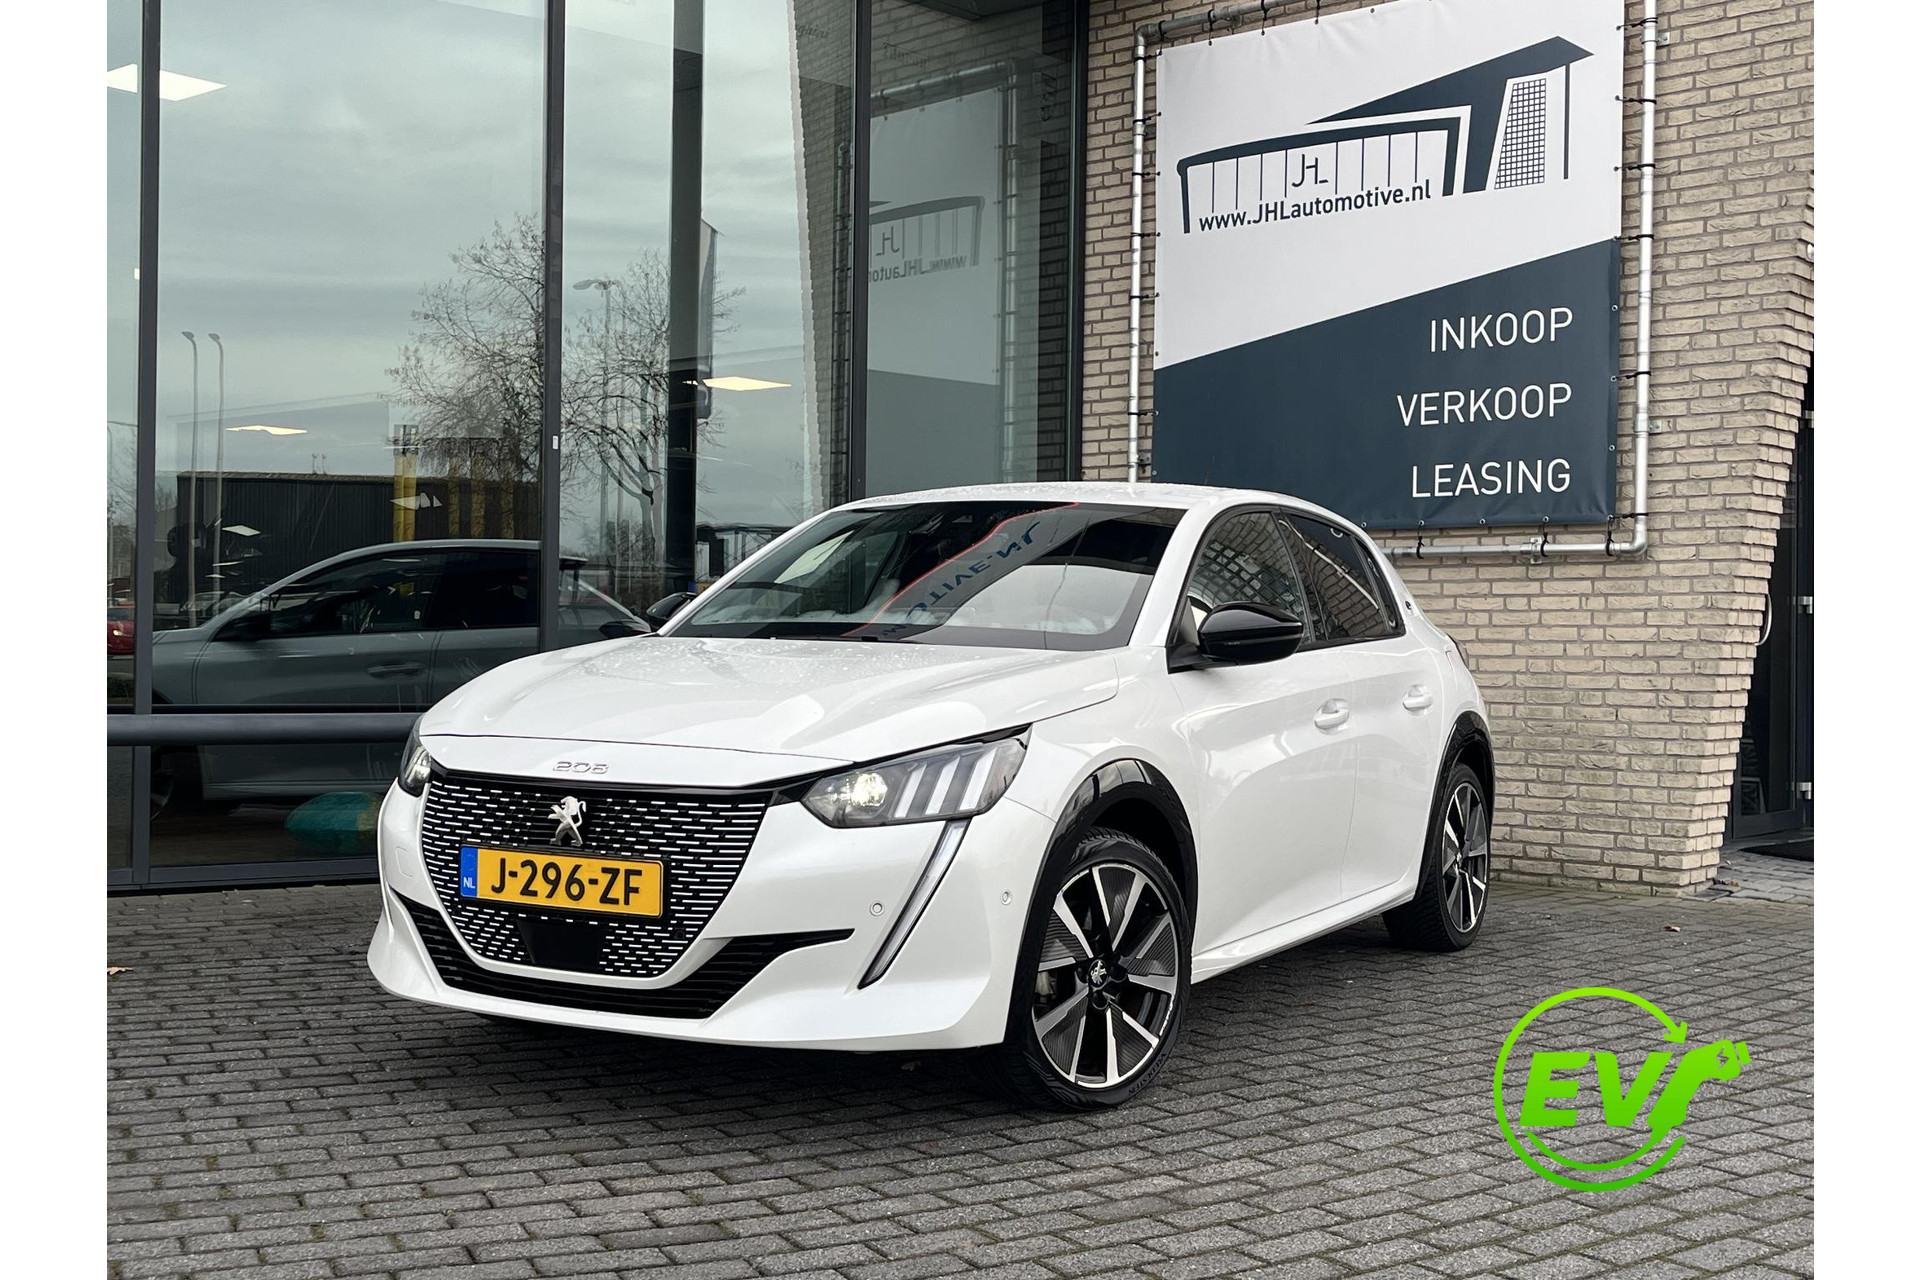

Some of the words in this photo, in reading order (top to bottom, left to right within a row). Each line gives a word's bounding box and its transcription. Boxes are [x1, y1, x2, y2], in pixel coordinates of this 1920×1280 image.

[1291, 153, 1329, 188] JHL
[1199, 179, 1432, 233] www.JHLautomotive.nl
[1429, 306, 1574, 353] INKOOP
[1396, 382, 1573, 427] VERKOOP
[1411, 457, 1572, 499] LEASING
[552, 761, 610, 775] 208
[463, 876, 476, 889] NL
[490, 857, 643, 907] J-296-ZF
